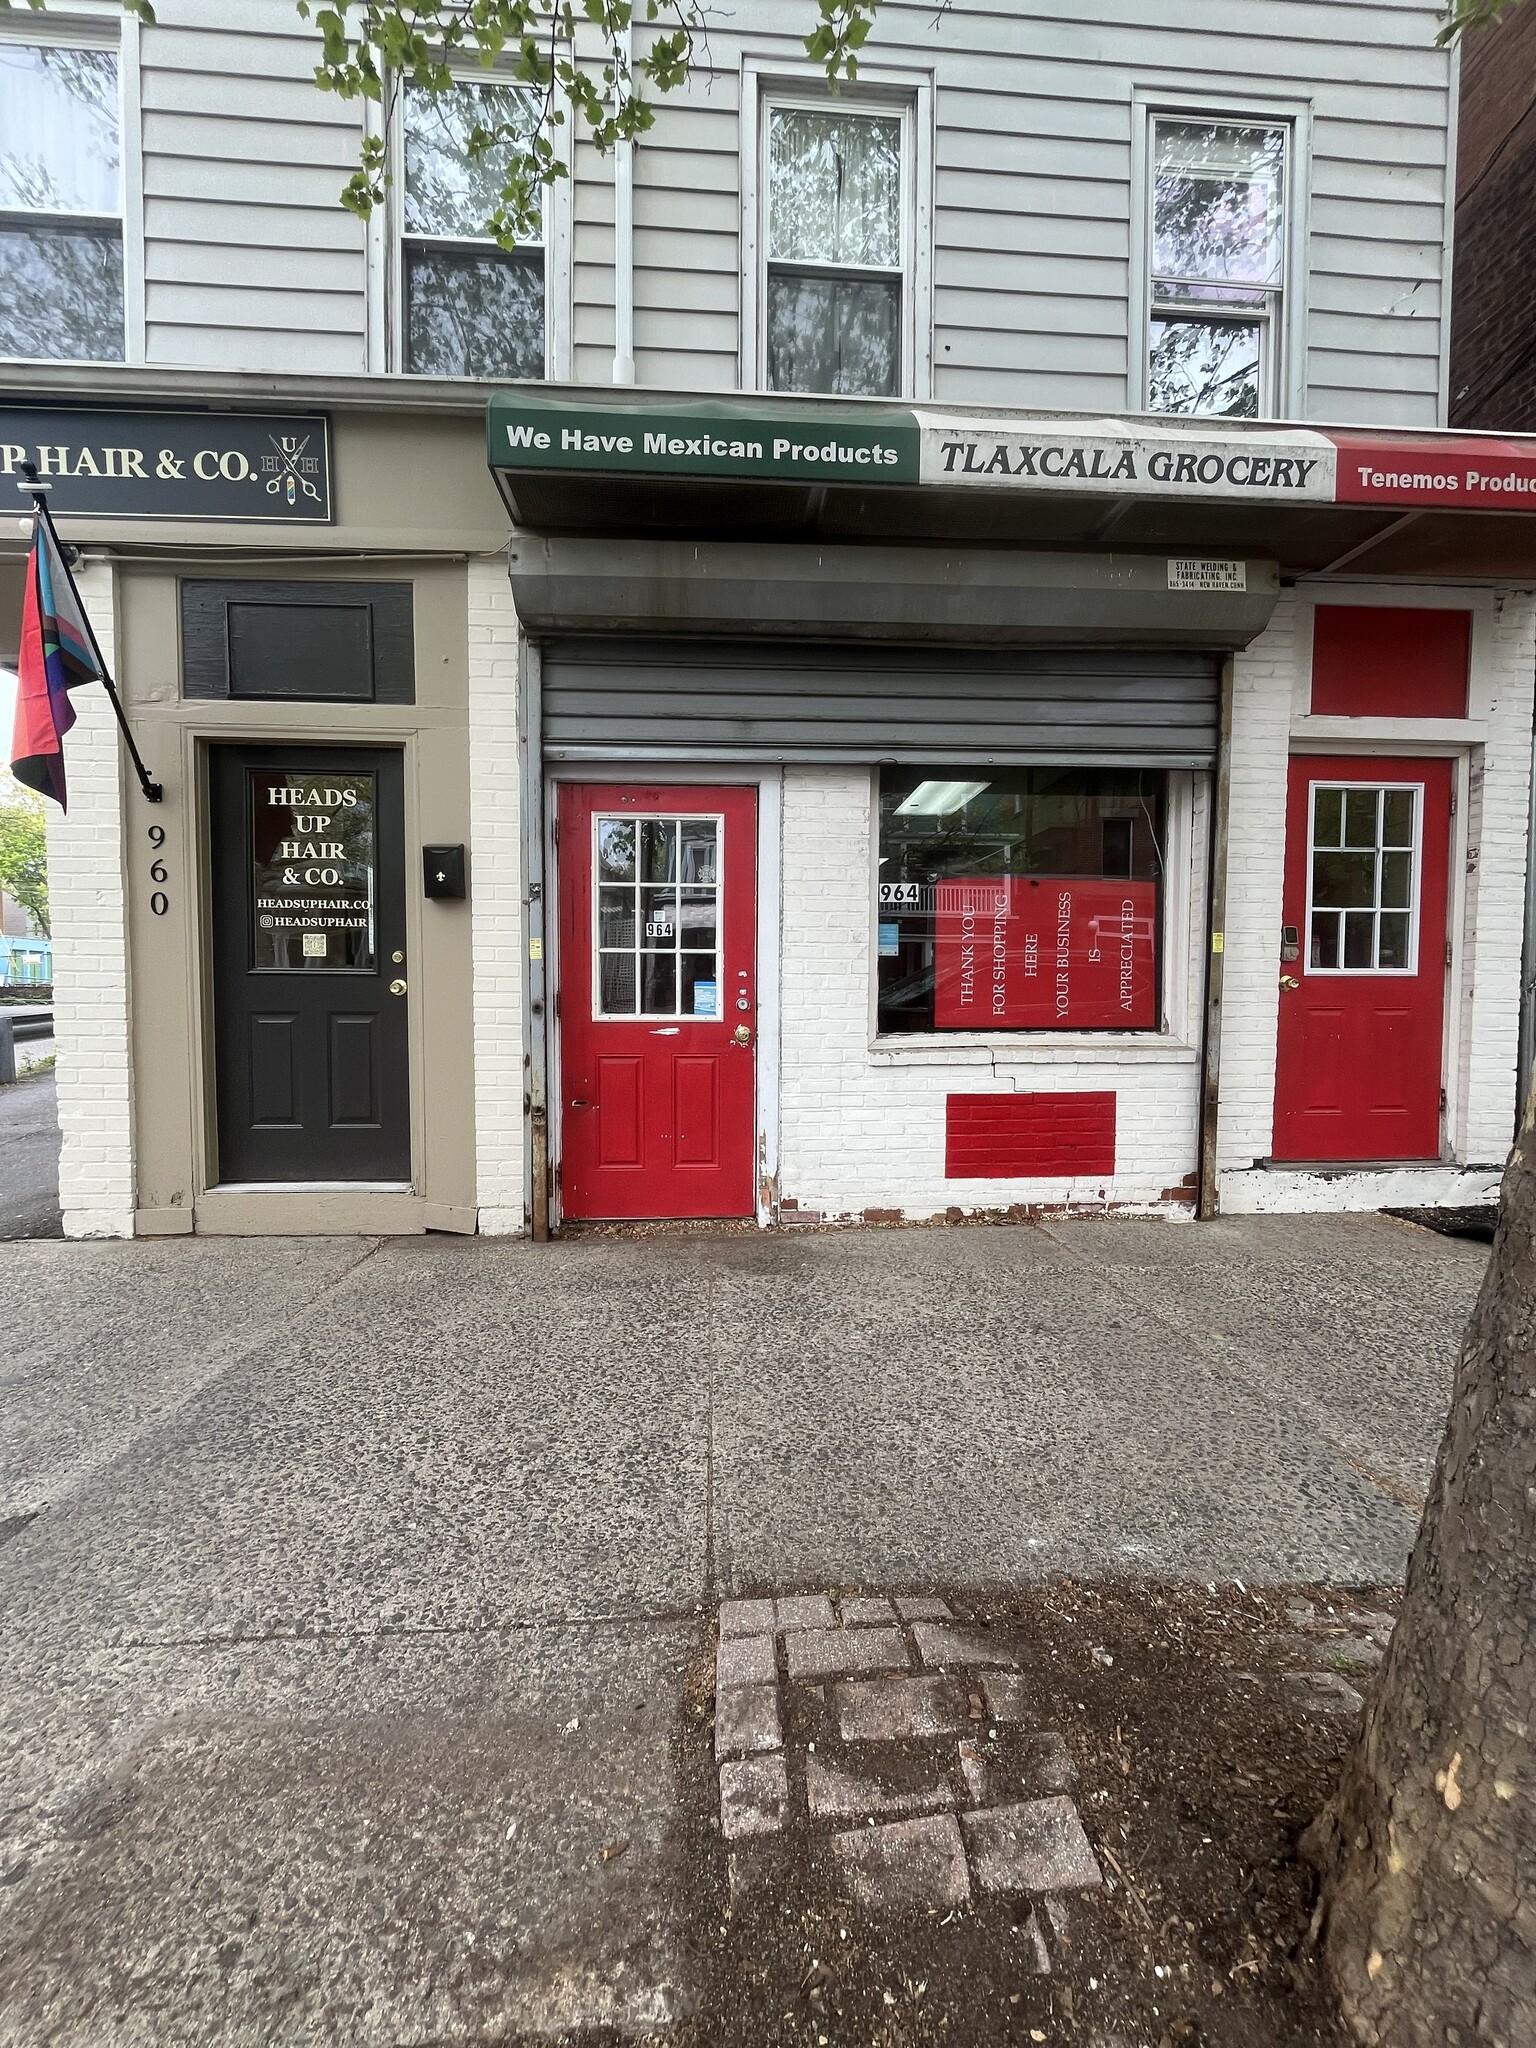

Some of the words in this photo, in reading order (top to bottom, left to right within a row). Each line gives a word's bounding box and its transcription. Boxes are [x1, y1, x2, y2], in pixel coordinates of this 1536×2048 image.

[280, 437, 297, 453] U
[506, 425, 551, 449] We
[561, 429, 633, 454] Have
[643, 433, 763, 459] Mexican
[773, 439, 899, 465] Products
[36, 446, 149, 479] HAIR
[155, 450, 186, 479] &
[193, 450, 258, 482] CO.
[940, 442, 1138, 480] TLAXCALA
[1147, 451, 1318, 488] GROCERY
[1358, 467, 1459, 490] Tenemos
[1176, 562, 1196, 570] STATE
[1201, 562, 1229, 572] WELDING
[1232, 563, 1237, 572] &
[268, 788, 357, 807] HEADS
[295, 815, 331, 833] UP
[281, 842, 346, 860] HAIR
[148, 825, 168, 915] 960
[282, 868, 301, 885] &
[304, 868, 344, 885] CO.
[881, 885, 918, 901] 964
[648, 924, 671, 936] 964
[962, 905, 976, 941] YOU
[993, 895, 1008, 979] SHOPPING
[1056, 892, 1071, 968] BUSINESS
[1025, 933, 1038, 977] HERE
[1088, 948, 1101, 963] IS
[1120, 899, 1134, 1012] APPRECIATED
[961, 945, 974, 1006] THANK
[993, 983, 1007, 1016] FOR
[1056, 973, 1069, 1019] YOUR
